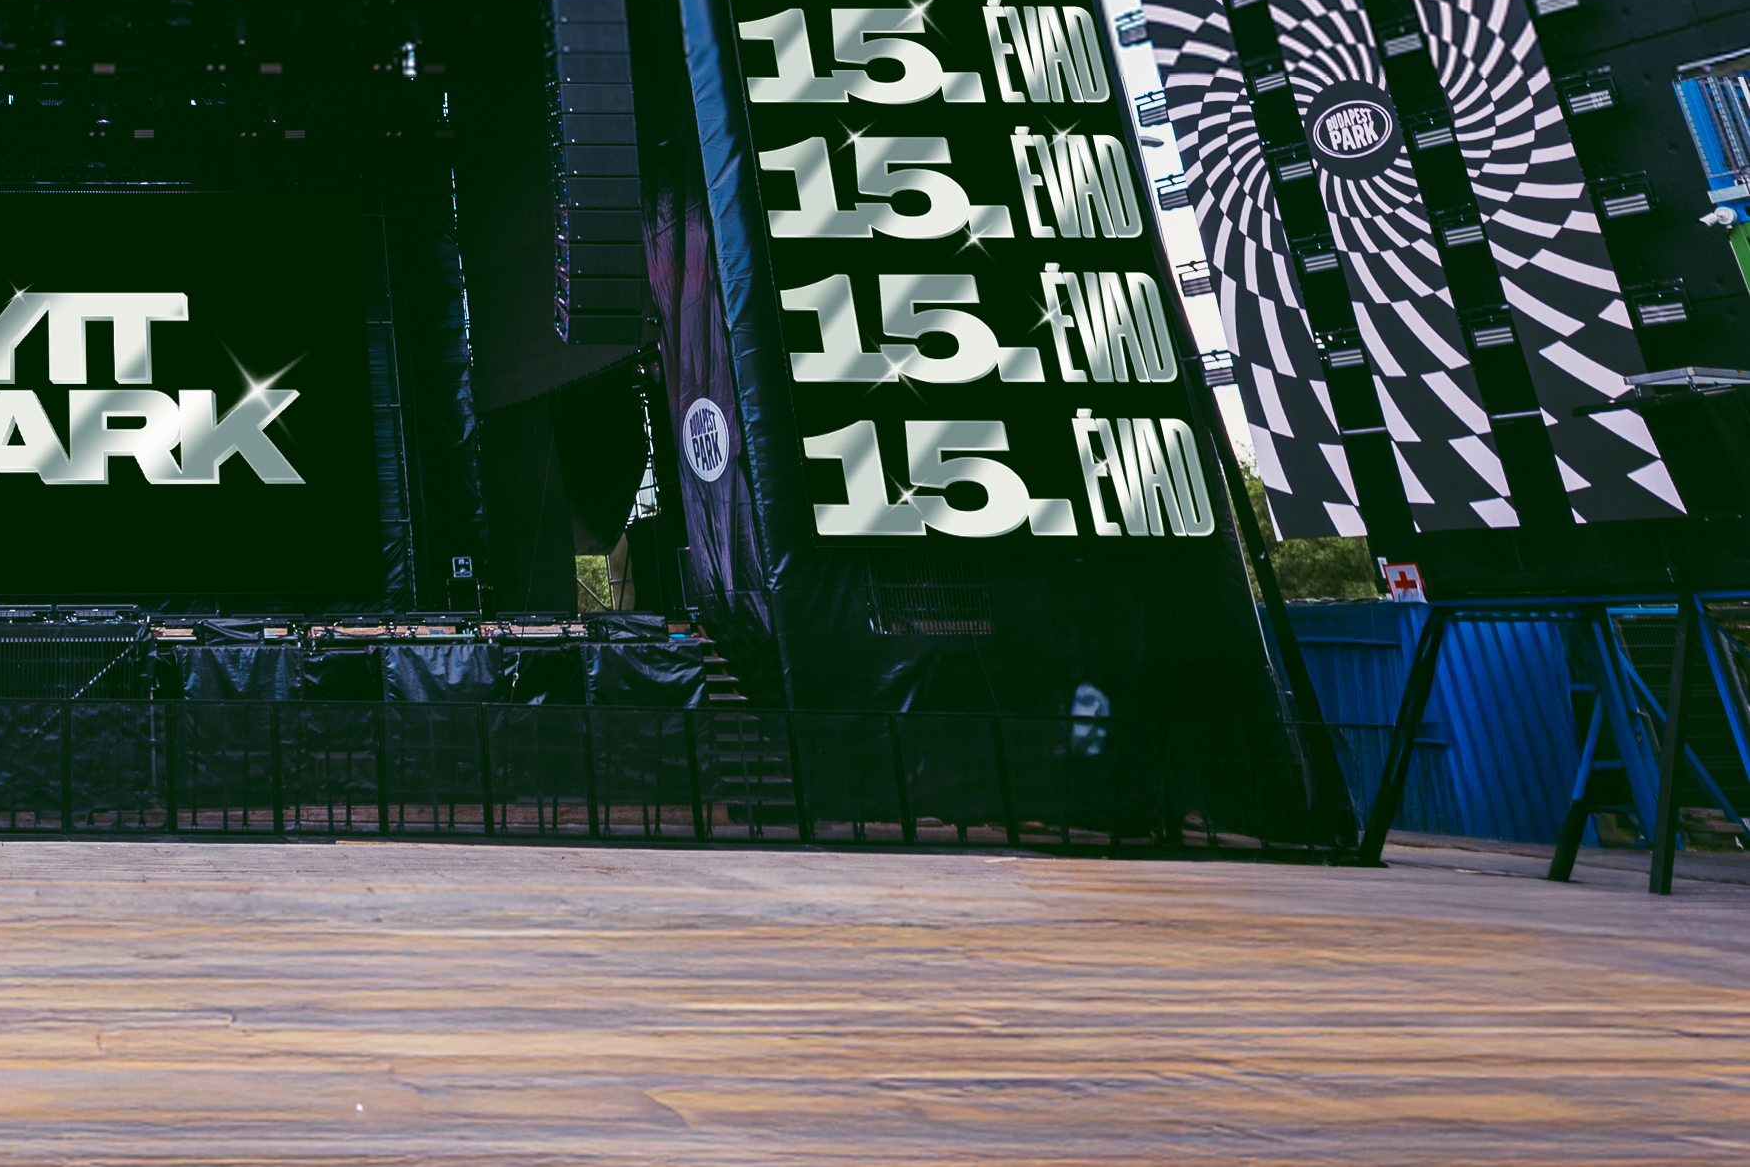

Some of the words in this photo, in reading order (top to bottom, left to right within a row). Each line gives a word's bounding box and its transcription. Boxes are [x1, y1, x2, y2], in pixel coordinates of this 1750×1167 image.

[738, 8, 986, 104] 15.
[1325, 107, 1373, 133] BUDAPEST
[1329, 120, 1379, 151] PARK
[758, 136, 1015, 239] 15.
[1010, 126, 1143, 239] ÉVAD
[780, 274, 1046, 384] 15.
[1040, 262, 1178, 383] ÉVAD
[692, 432, 722, 471] PARK
[803, 420, 1078, 538] 15.
[1071, 408, 1215, 537] ÉVAD
